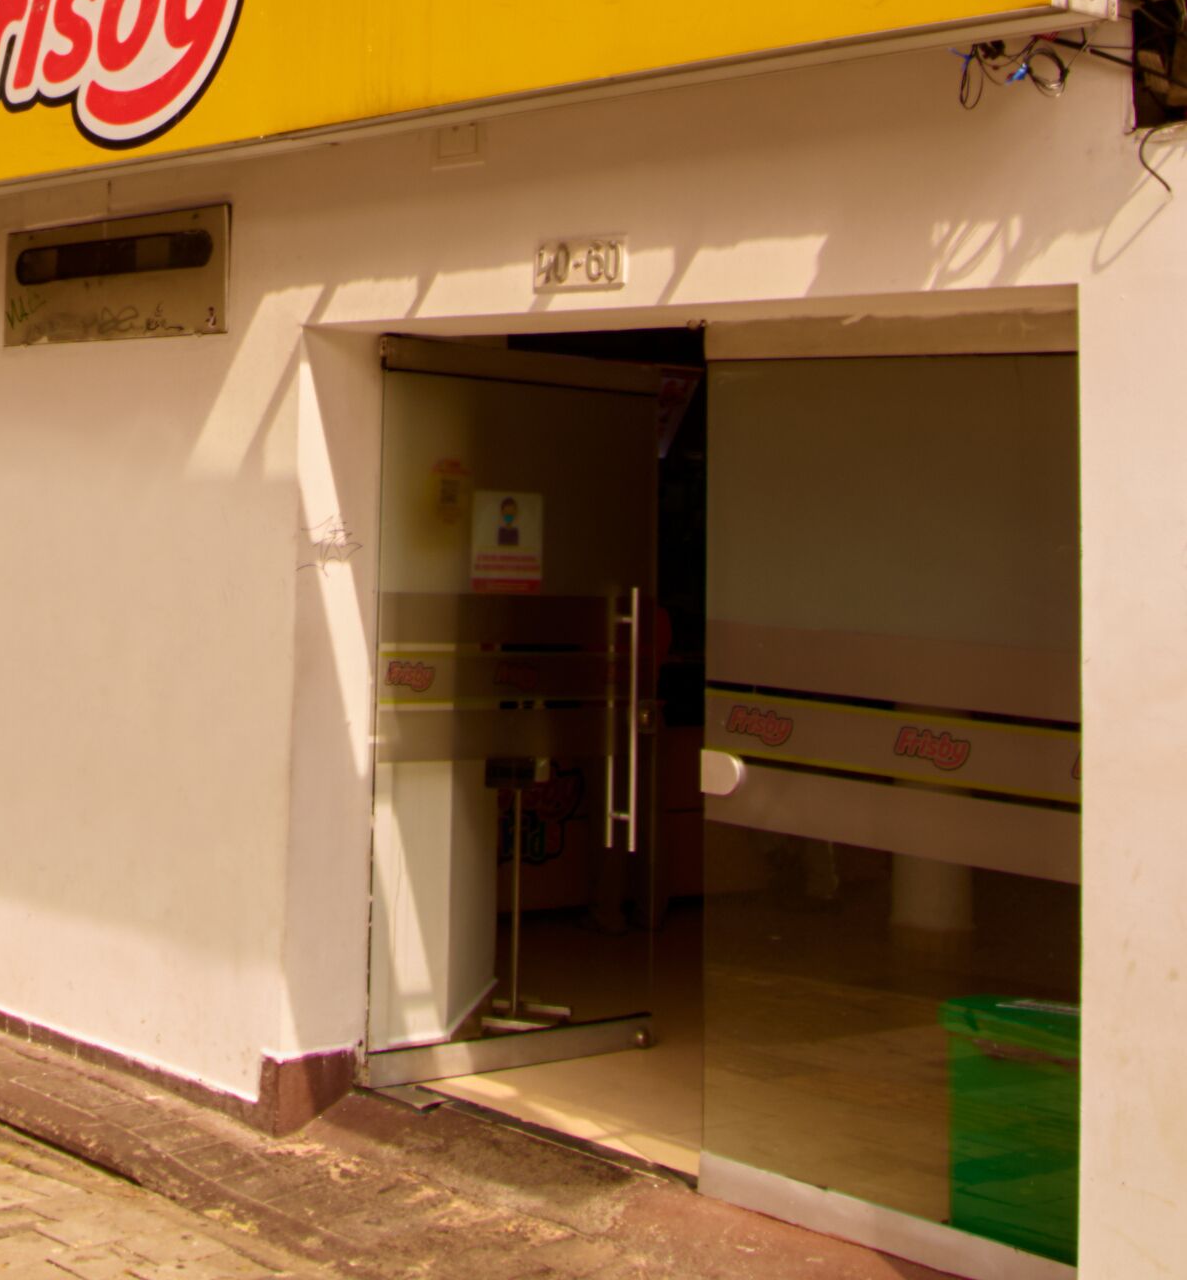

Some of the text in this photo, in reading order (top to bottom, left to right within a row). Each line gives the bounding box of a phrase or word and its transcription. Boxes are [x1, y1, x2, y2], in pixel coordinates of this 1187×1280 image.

[537, 240, 621, 284] 40-60
[385, 661, 435, 692] Frisby
[725, 706, 792, 746] Frisby
[895, 727, 970, 770] Frisby
